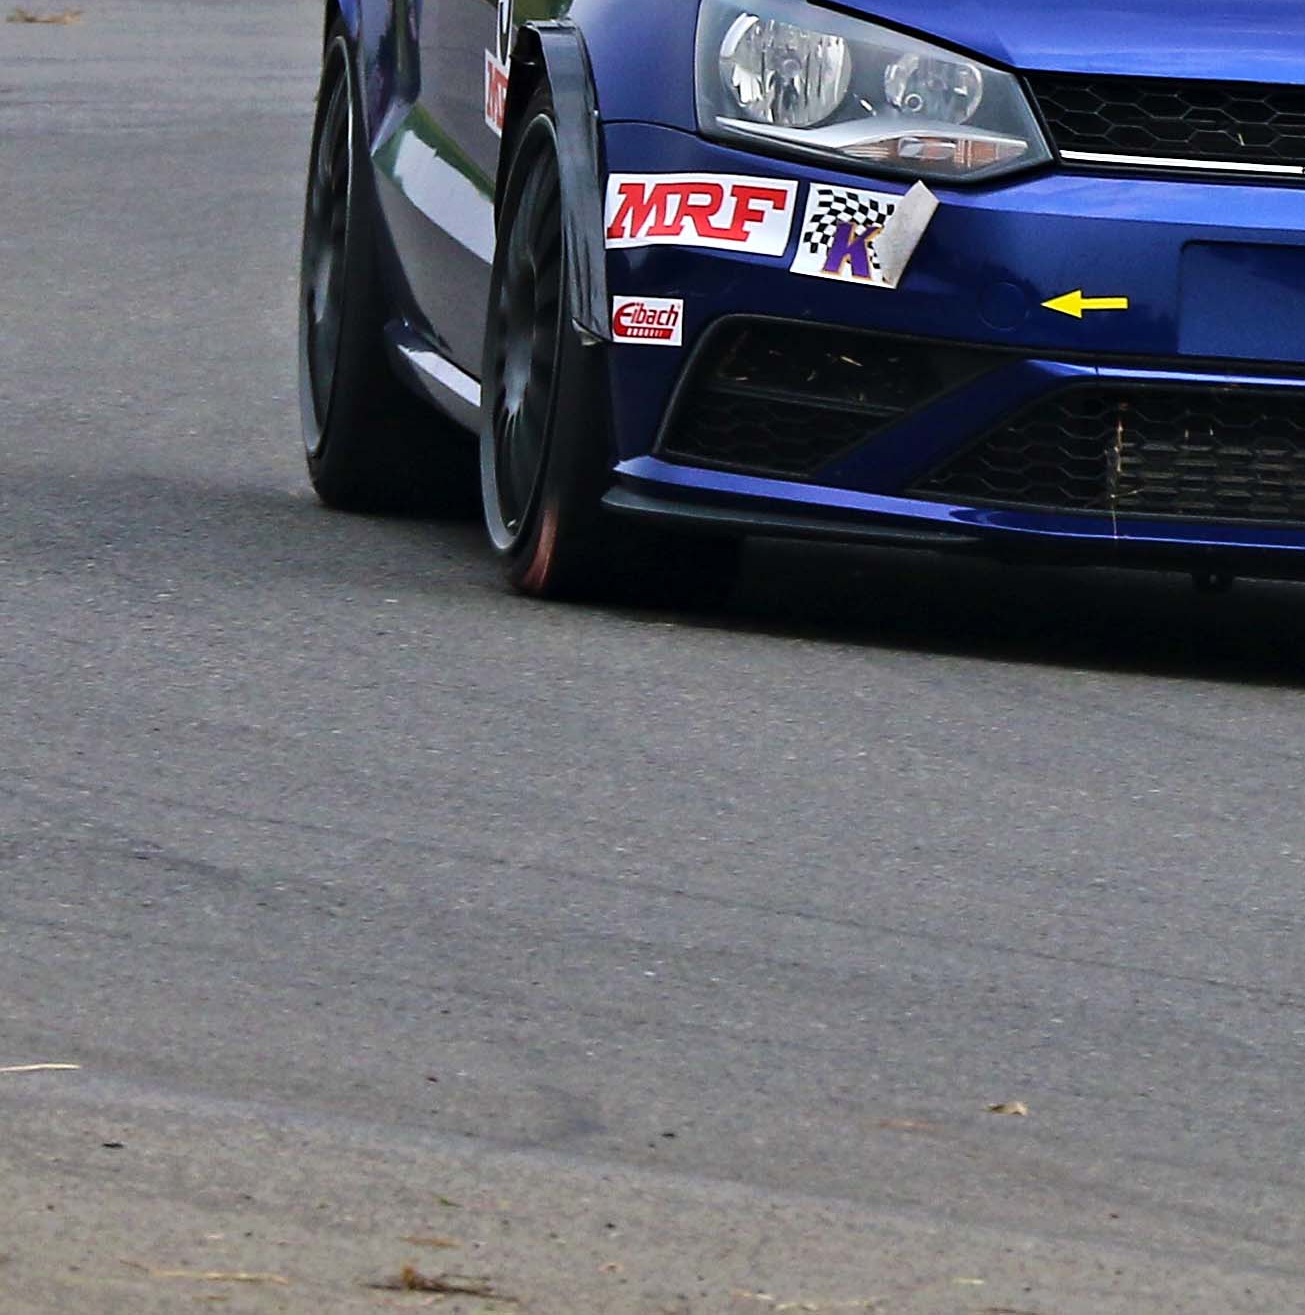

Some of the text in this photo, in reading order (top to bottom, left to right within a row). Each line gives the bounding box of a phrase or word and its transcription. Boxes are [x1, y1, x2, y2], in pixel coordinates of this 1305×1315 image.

[606, 182, 788, 242] MRF
[821, 221, 886, 280] K
[613, 302, 679, 340] Eibach
